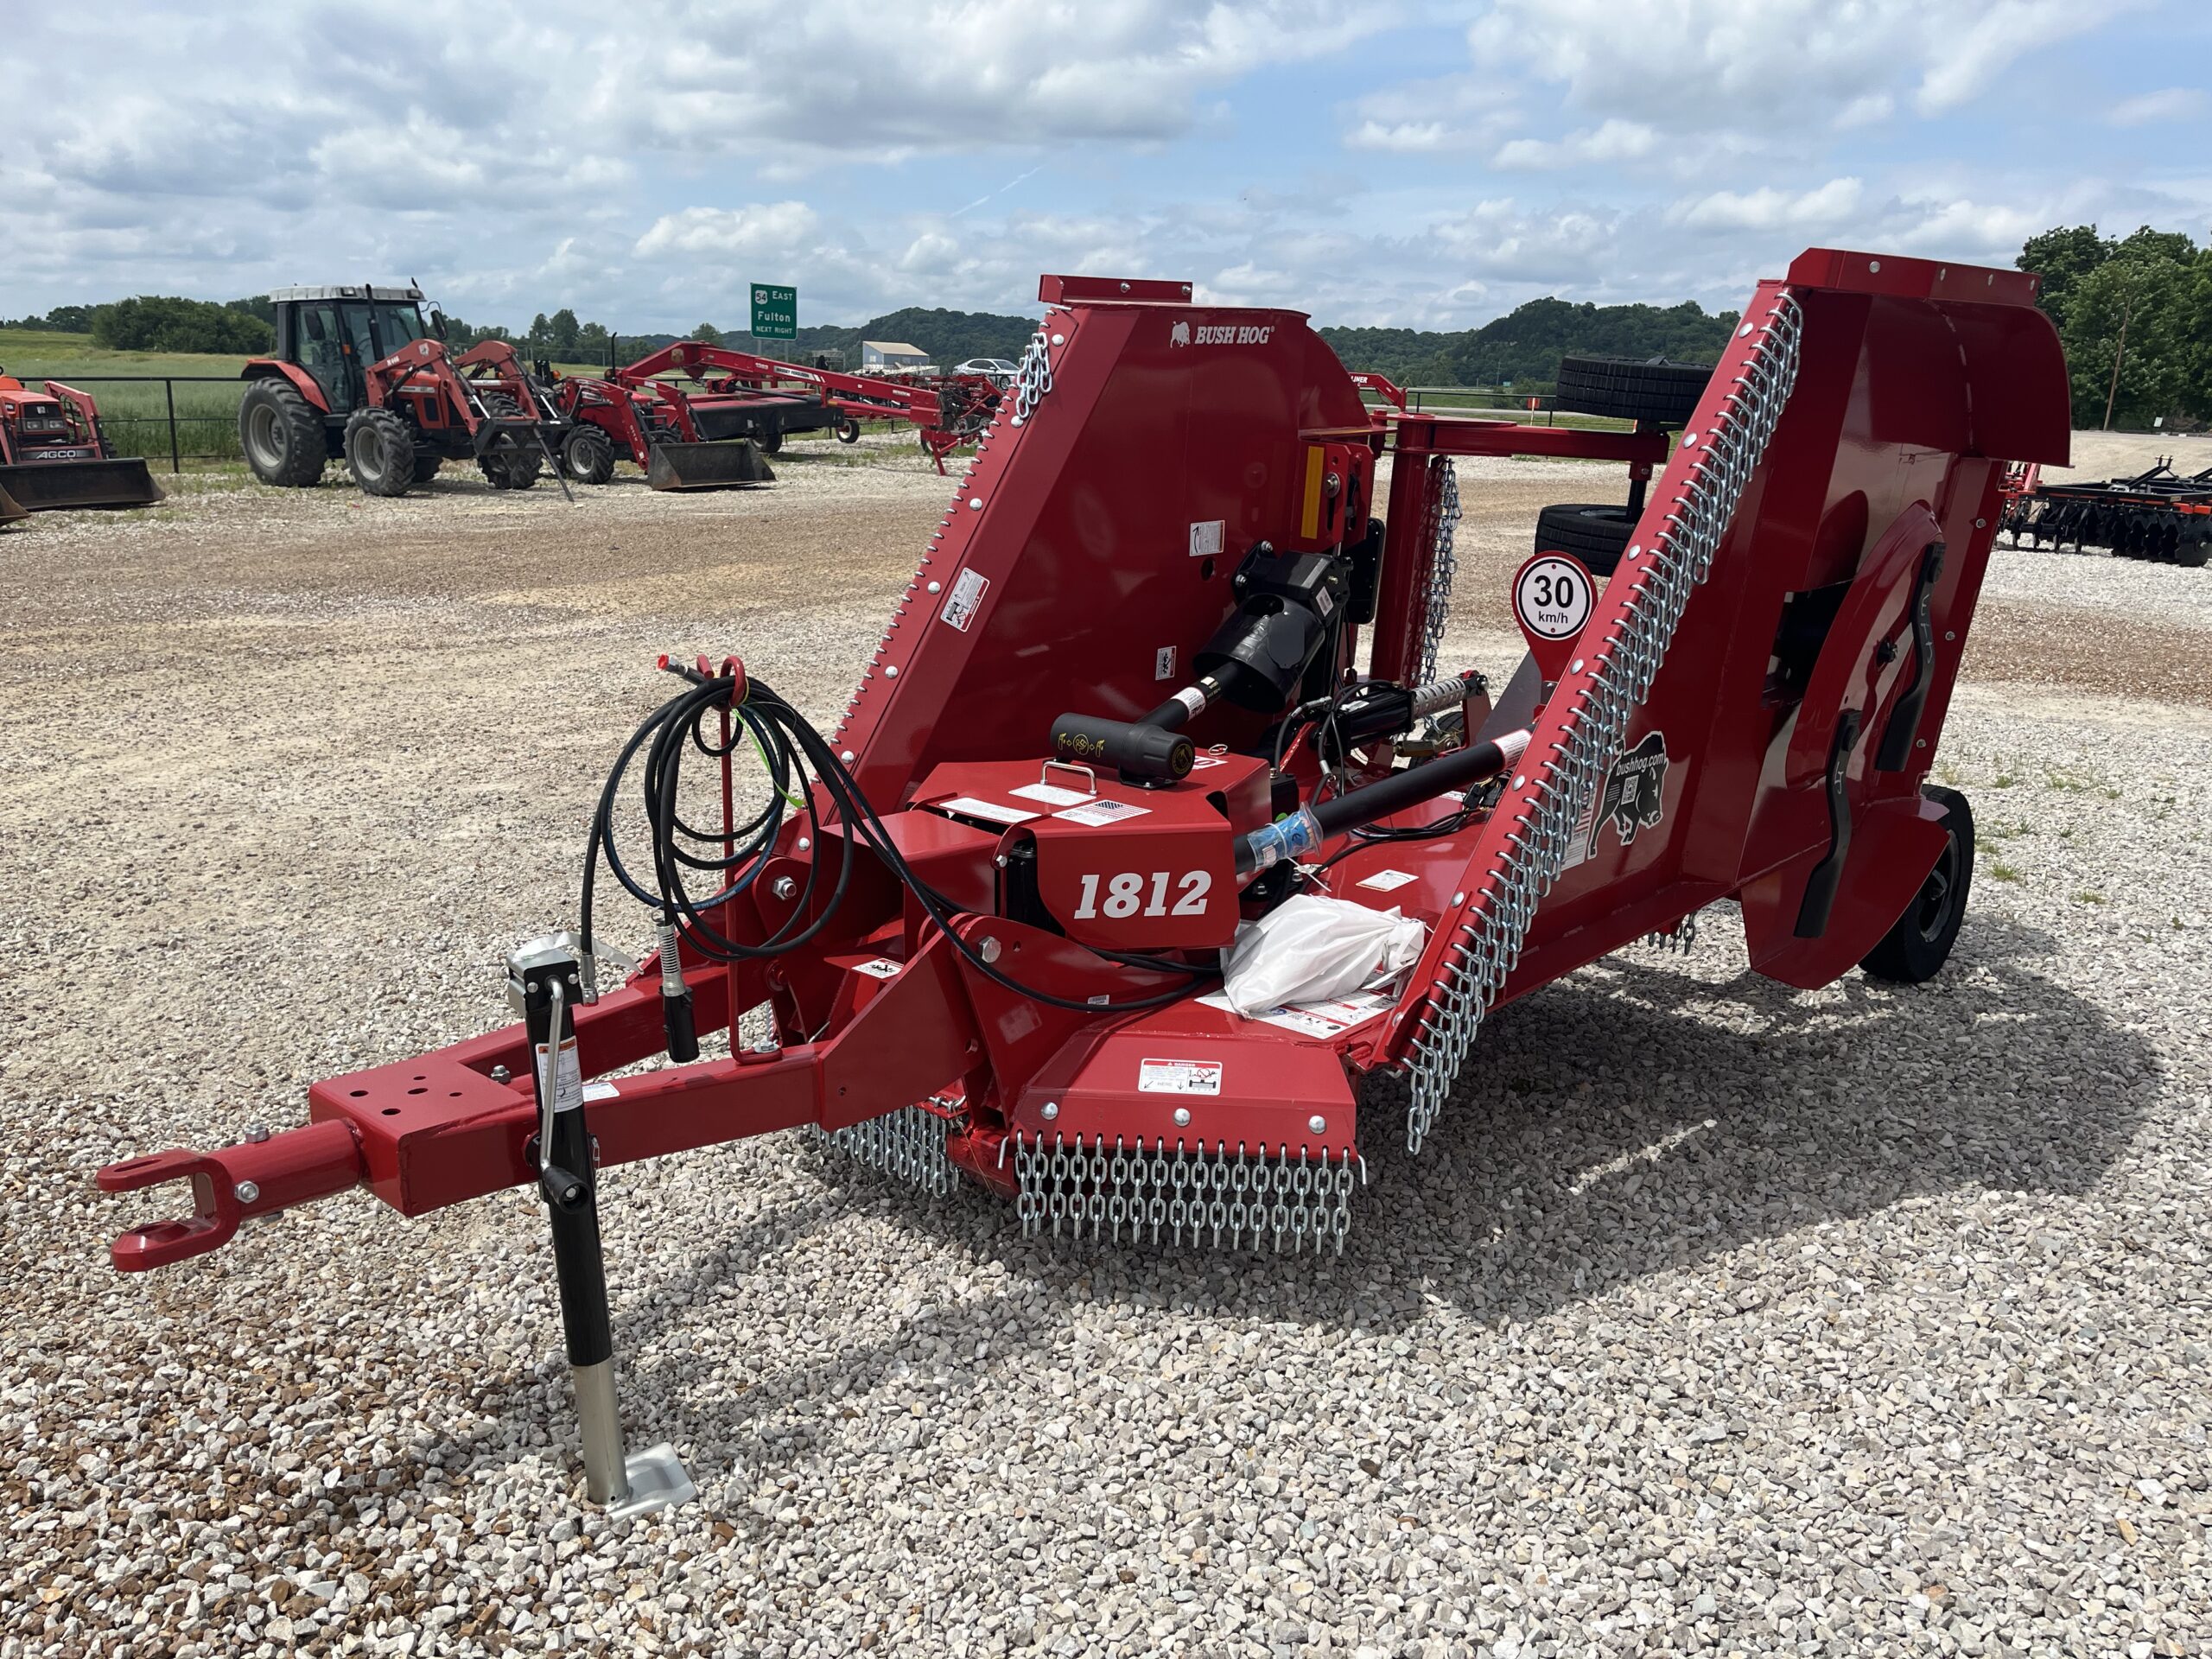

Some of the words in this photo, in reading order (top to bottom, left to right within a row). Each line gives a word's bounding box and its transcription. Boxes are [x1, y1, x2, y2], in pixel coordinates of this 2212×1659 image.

[756, 293, 766, 302] 54
[772, 290, 793, 301] EAST
[758, 310, 791, 322] Fulton
[1194, 326, 1236, 344] BUSH
[1236, 326, 1270, 344] HOG
[36, 449, 77, 460] AGCO
[1533, 575, 1574, 608] 30
[1538, 610, 1568, 624] km/h
[1616, 753, 1664, 777] bushhog.com
[1073, 870, 1212, 919] 1812
